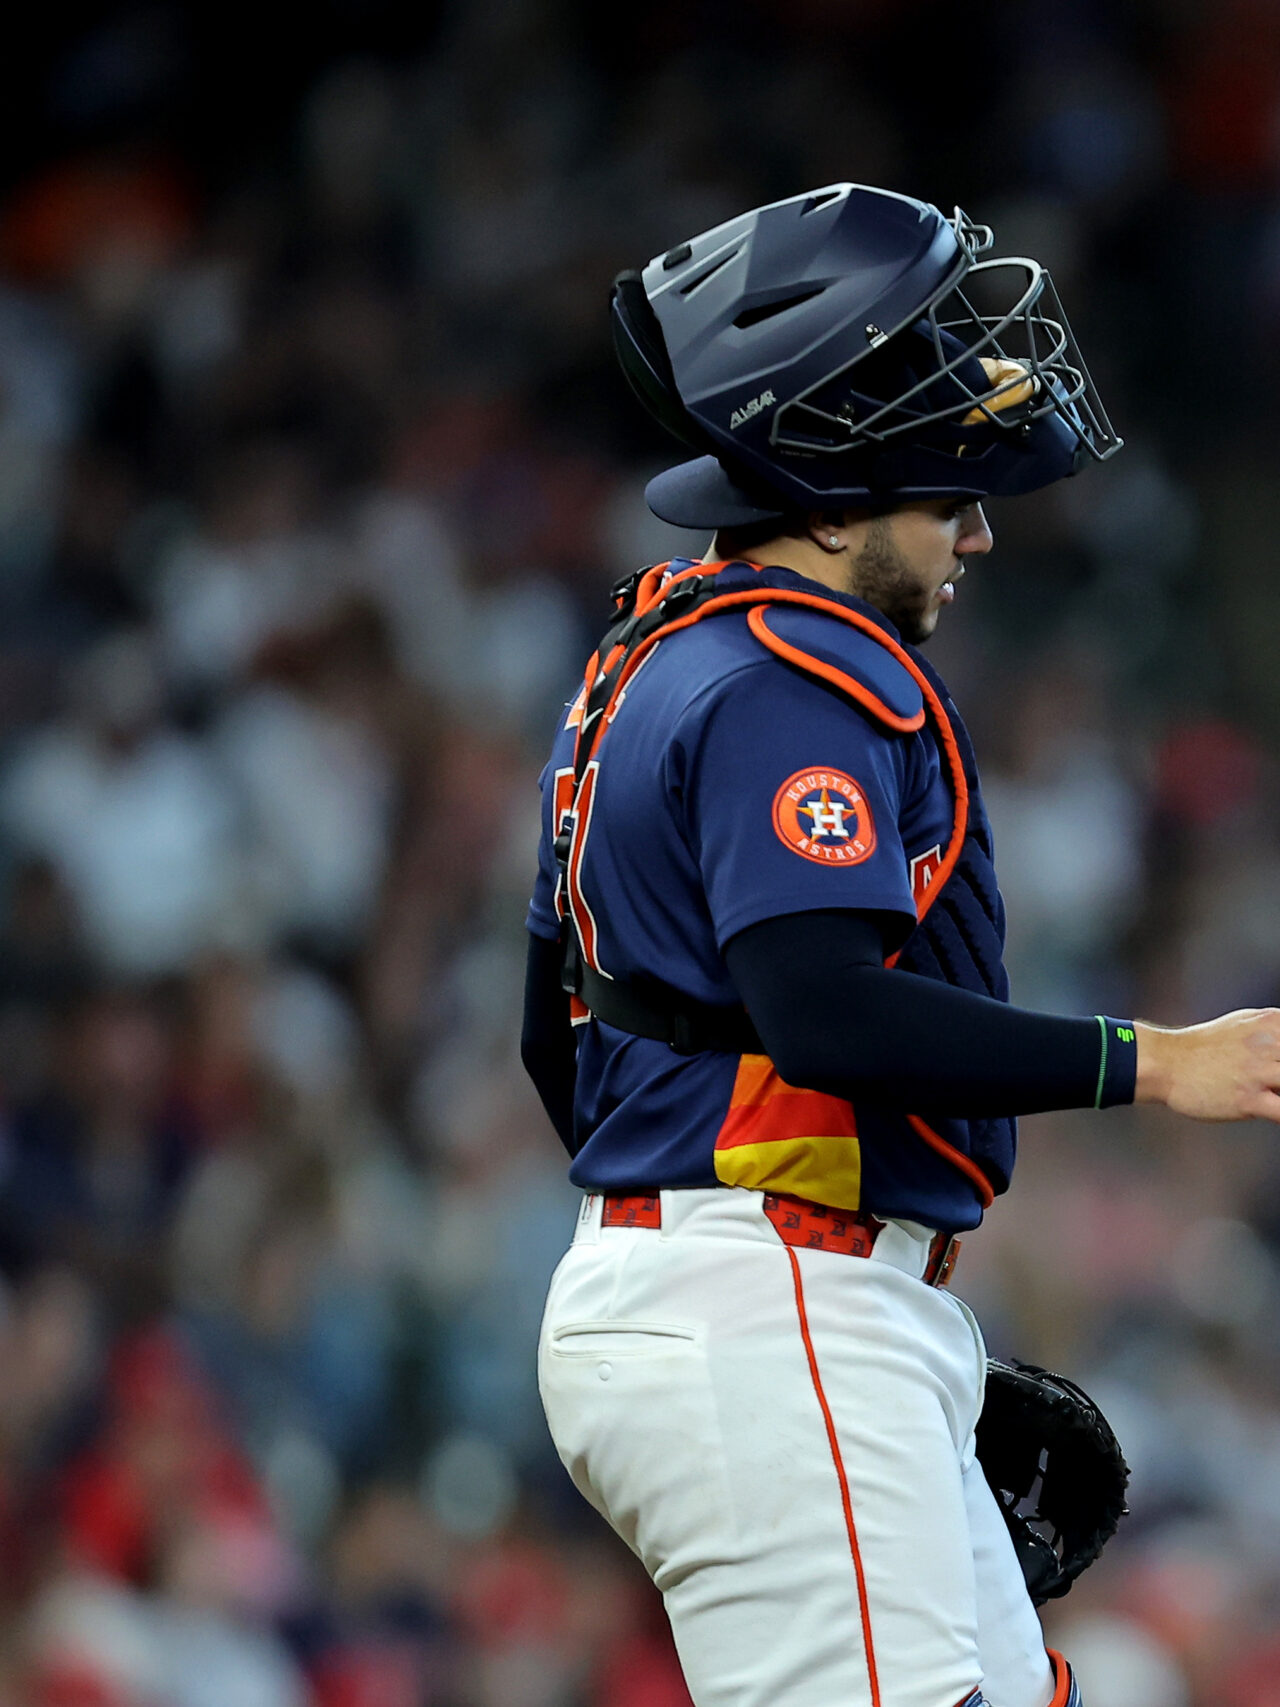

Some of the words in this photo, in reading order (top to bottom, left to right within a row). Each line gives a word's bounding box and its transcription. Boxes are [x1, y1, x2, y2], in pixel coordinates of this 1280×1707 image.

[786, 774, 861, 803] HOUSTON
[806, 800, 850, 836] H
[796, 838, 867, 859] ASTROS
